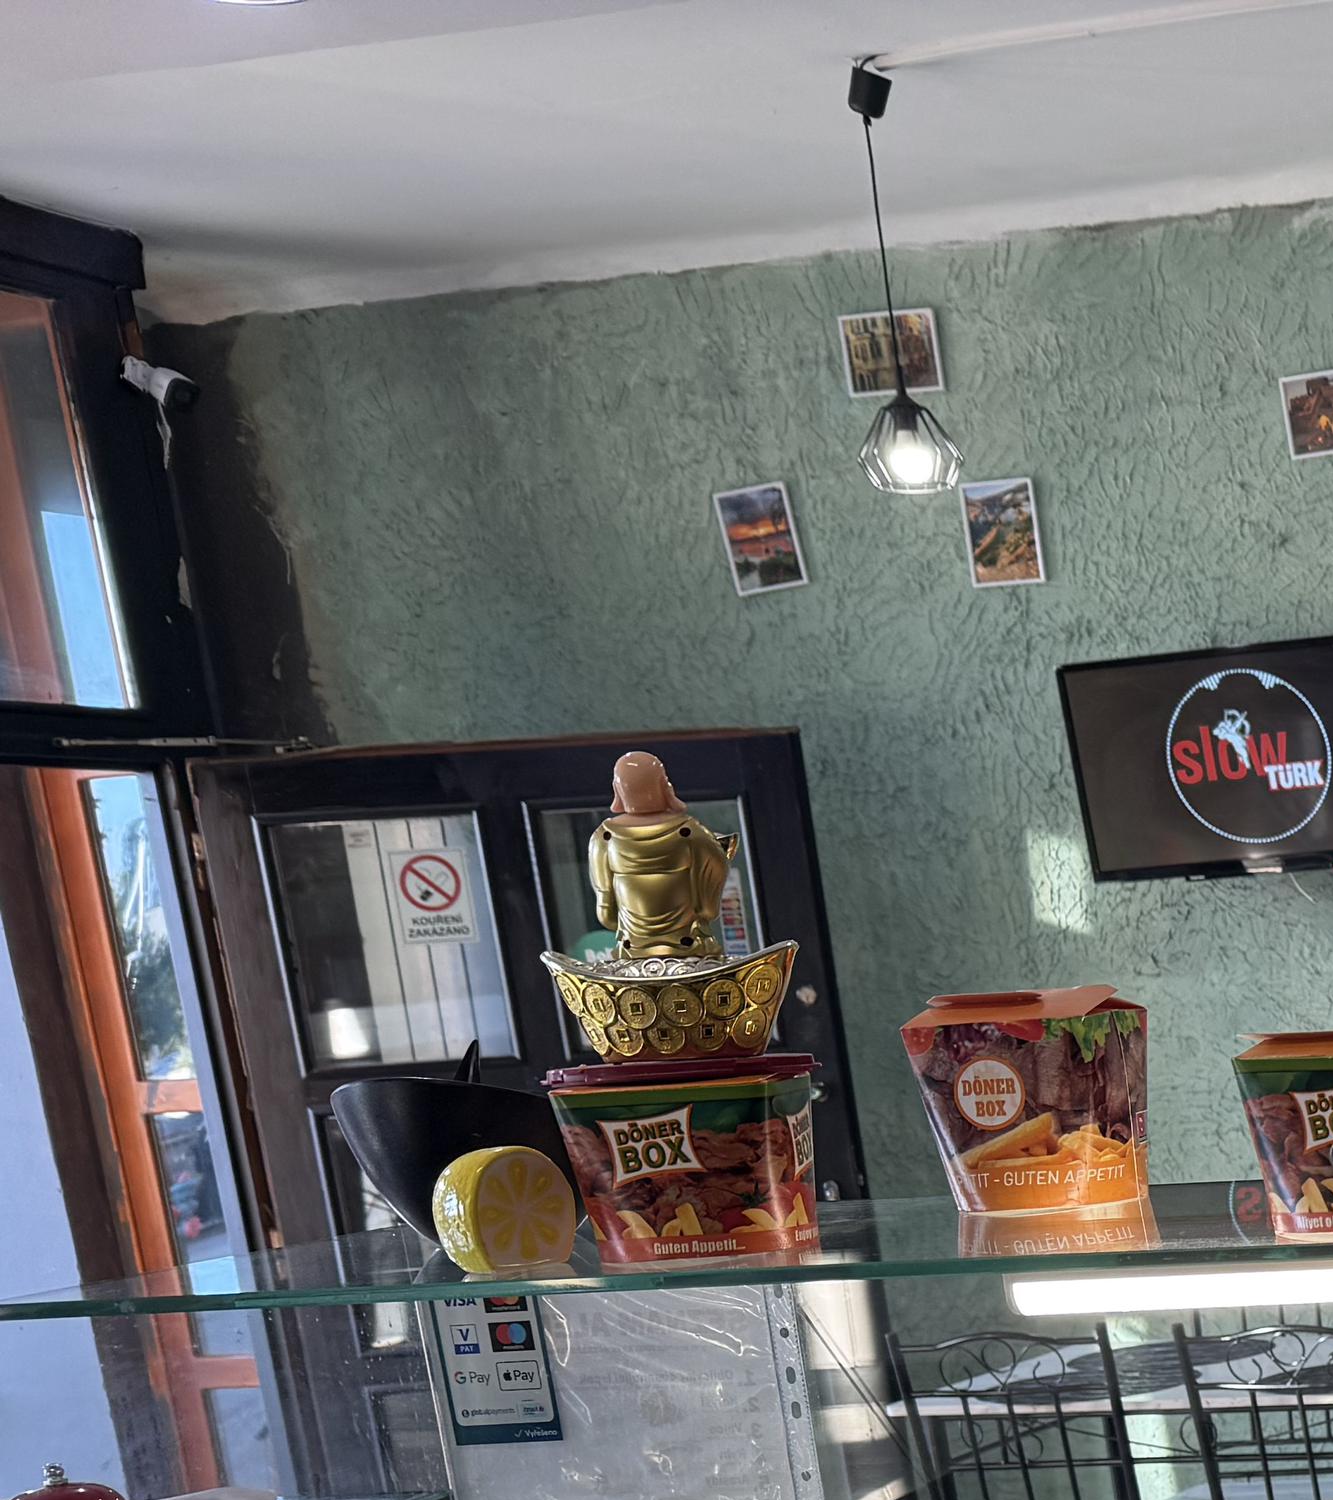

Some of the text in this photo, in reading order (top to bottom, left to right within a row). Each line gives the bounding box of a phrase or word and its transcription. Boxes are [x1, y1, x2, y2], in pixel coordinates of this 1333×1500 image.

[1265, 760, 1325, 790] TÜRK
[961, 1076, 1016, 1097] DÖNER
[975, 1099, 1007, 1118] BOX
[614, 1119, 685, 1147] DÖNER
[617, 1136, 692, 1174] BOX
[1003, 1169, 1059, 1187] GUTEN
[1063, 1164, 1126, 1184] APPETIT
[654, 1238, 690, 1255] Guten
[458, 1328, 470, 1342] V
[469, 1371, 491, 1386] Pay
[513, 1369, 535, 1383] Pay
